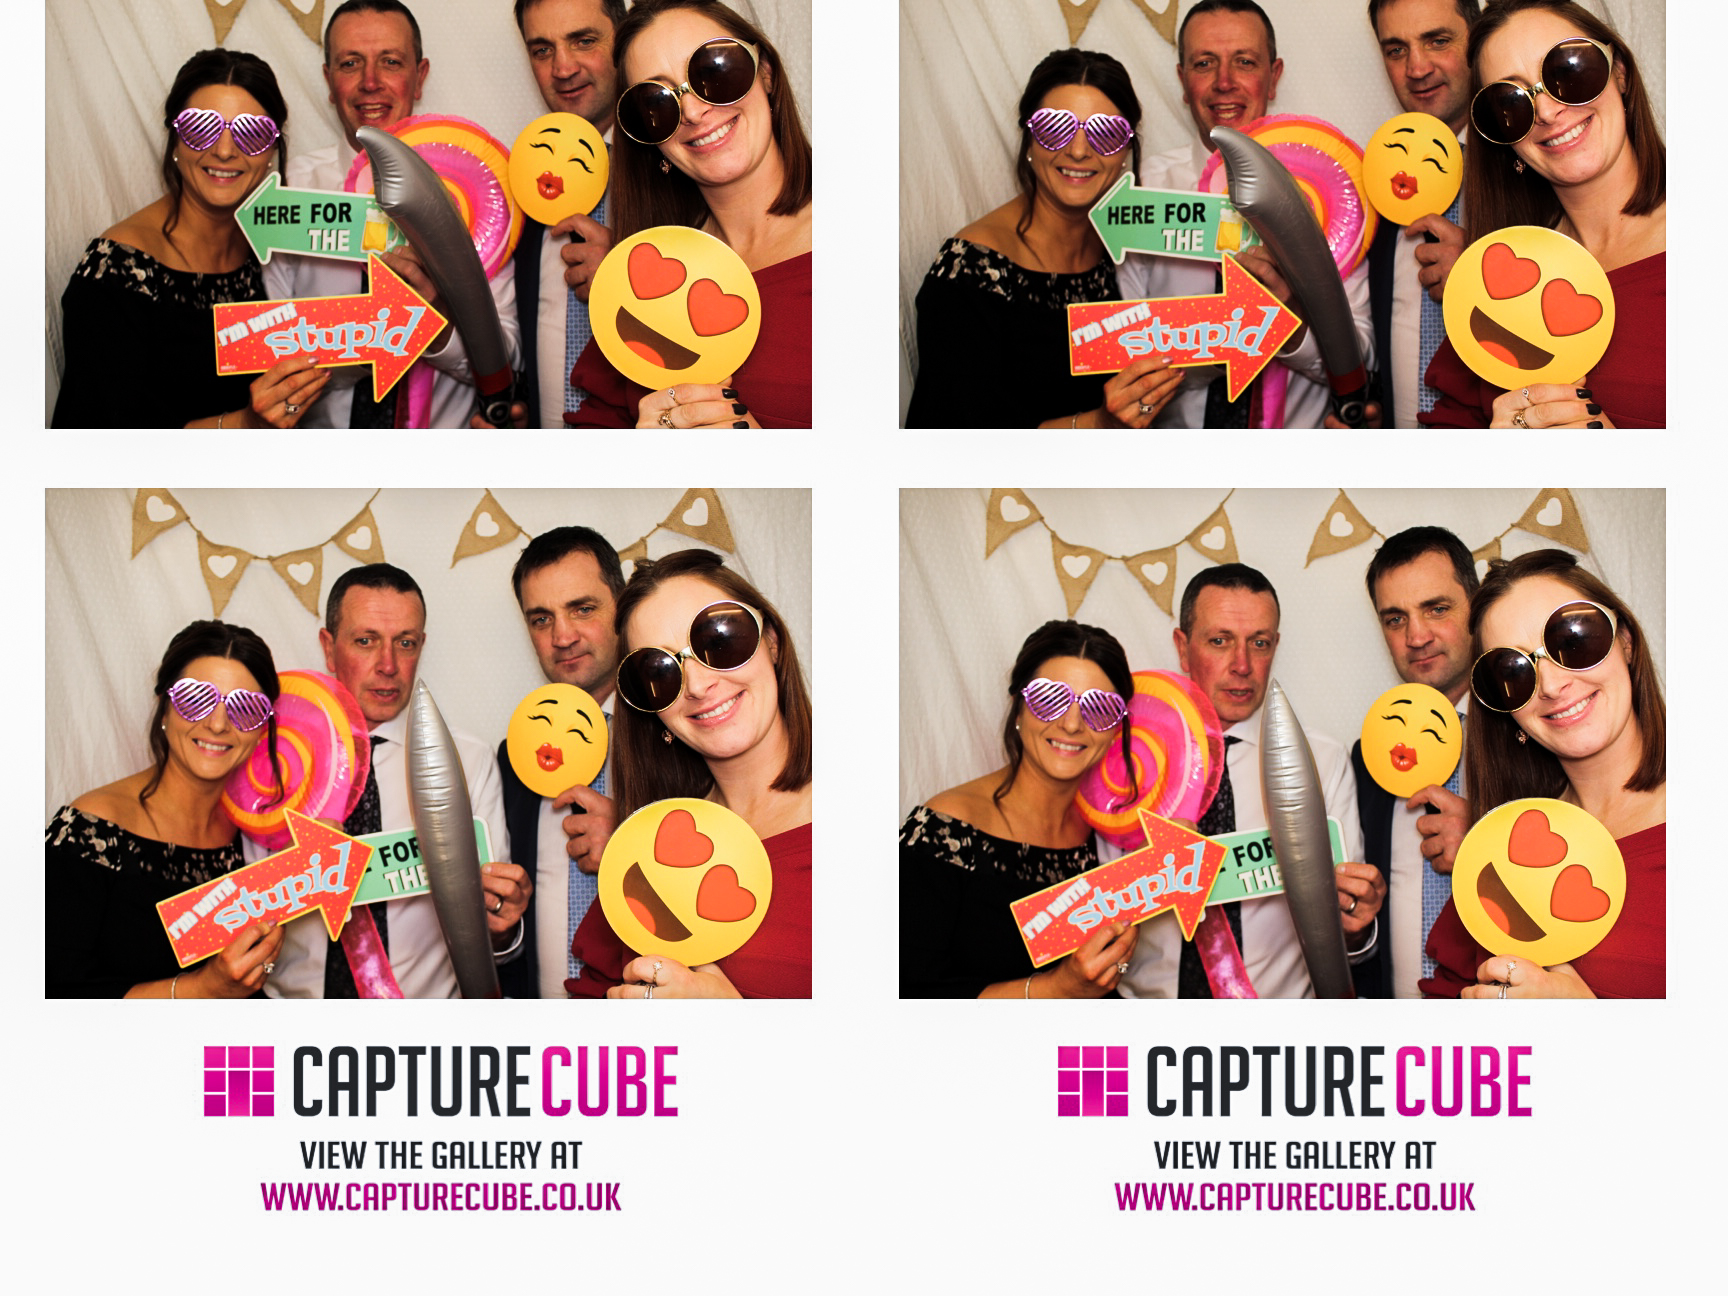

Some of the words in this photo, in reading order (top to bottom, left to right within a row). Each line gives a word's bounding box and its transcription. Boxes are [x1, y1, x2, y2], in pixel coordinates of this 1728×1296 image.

[253, 204, 301, 225] HERE
[310, 202, 352, 223] FOR
[1107, 204, 1155, 225] HERE
[1164, 202, 1206, 223] FOR
[308, 228, 350, 252] THE
[1162, 228, 1204, 252] THE
[264, 306, 427, 359] stupid
[1118, 306, 1281, 359] stupid
[213, 840, 353, 933] stupid
[383, 864, 429, 893] THE
[1067, 840, 1207, 933] stupid
[1237, 864, 1283, 893] THE
